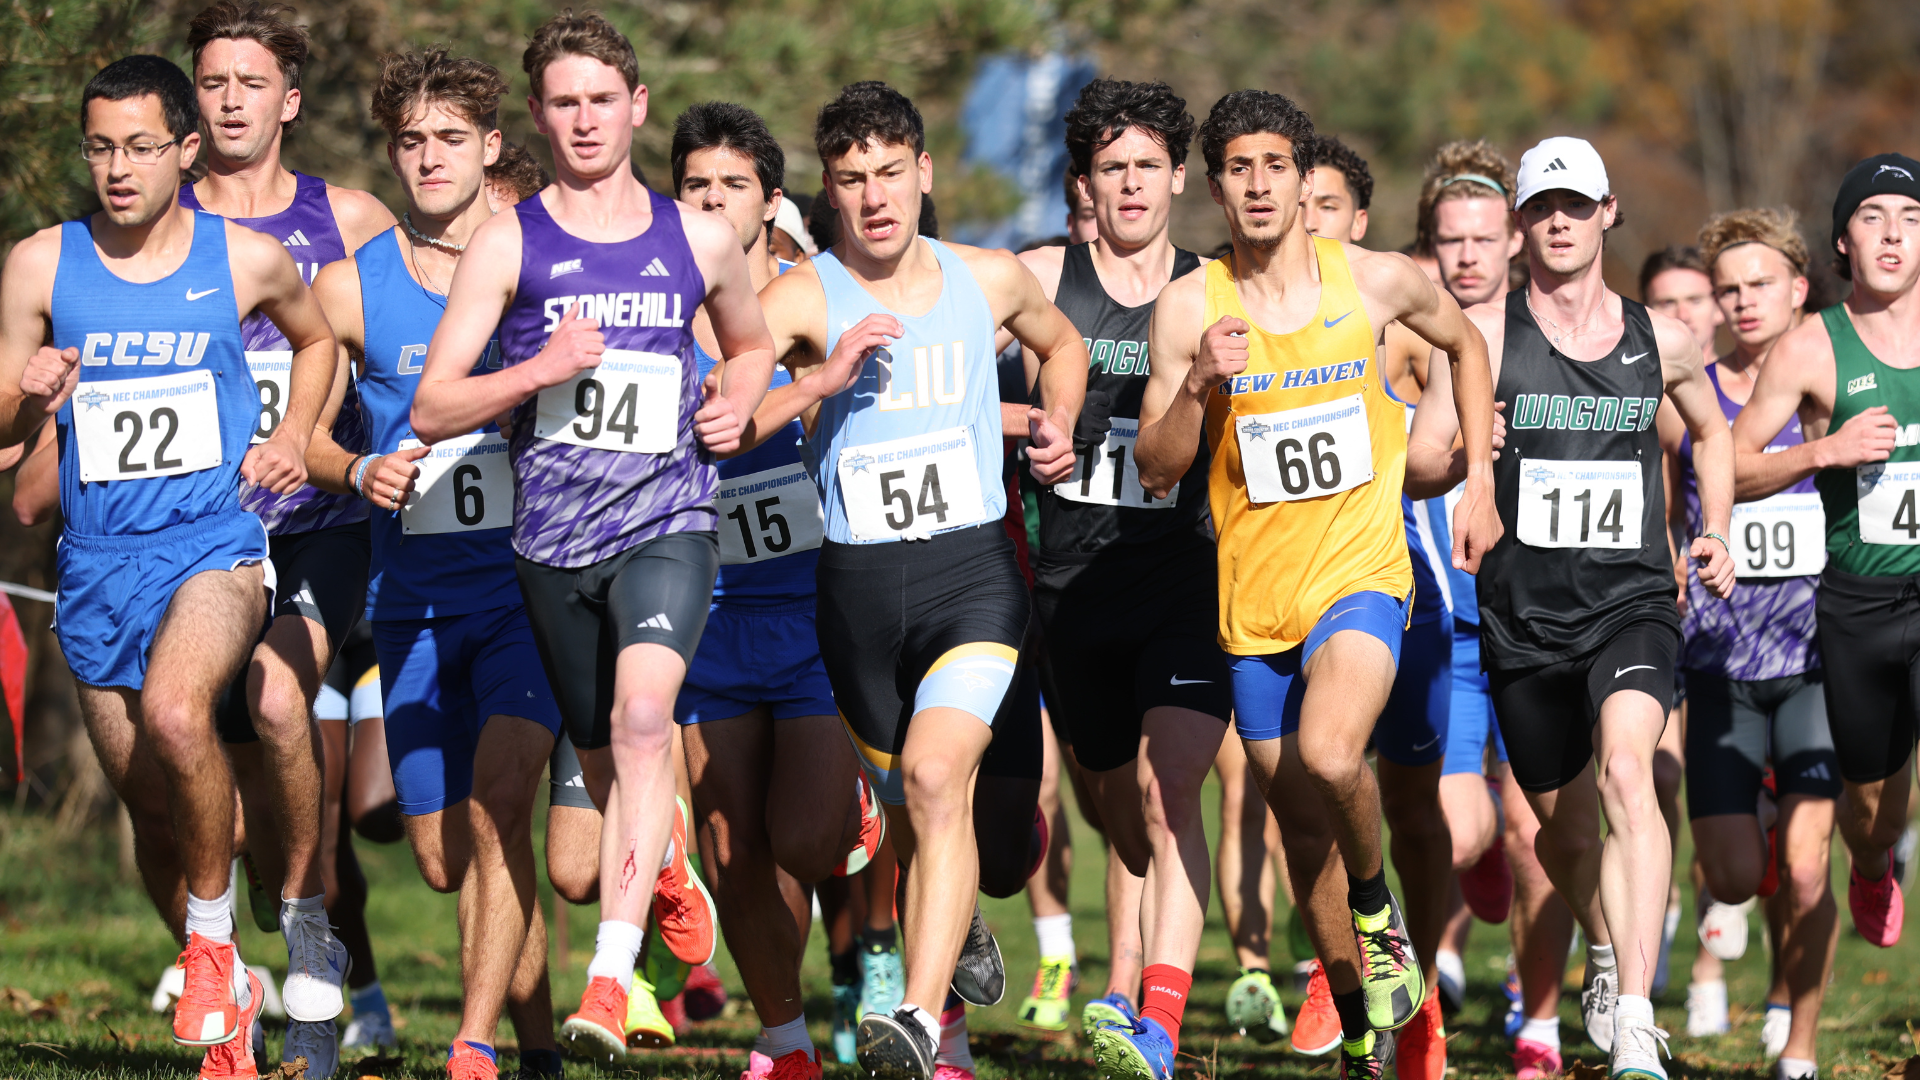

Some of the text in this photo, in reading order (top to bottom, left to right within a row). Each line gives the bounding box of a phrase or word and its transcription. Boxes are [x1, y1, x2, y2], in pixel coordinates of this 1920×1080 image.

[550, 258, 583, 276] NEC
[543, 292, 685, 333] STONEHILL
[82, 332, 211, 366] CCSU
[601, 361, 676, 376] CHAMPIONSHIPS
[876, 340, 967, 412] LIU
[1217, 358, 1368, 395] NEW HAVEN
[1847, 373, 1876, 393] NEC
[112, 391, 131, 402] NEC
[133, 382, 209, 401] CHAMPIONSHIPS
[573, 378, 639, 445] 94
[1273, 405, 1361, 433] NEC CHAMPIONSHIPS
[1512, 394, 1658, 432] WAGNER
[114, 407, 183, 473] 22
[436, 448, 454, 458] NEC
[877, 452, 895, 464] NEC
[897, 438, 967, 461] CHAMPIONSHIPS
[1275, 431, 1342, 495] 66
[1575, 472, 1637, 480] CHAMPIONSHIPS
[1893, 473, 1909, 482] NEC
[453, 464, 485, 526] 6
[720, 471, 808, 499] NEC CHAMPIONSHIPS
[879, 463, 950, 531] 54
[727, 496, 791, 558] 15
[1542, 488, 1624, 543] 114
[1892, 489, 1920, 539] 4
[1744, 521, 1795, 570] 99
[1150, 985, 1183, 1000] SMART
